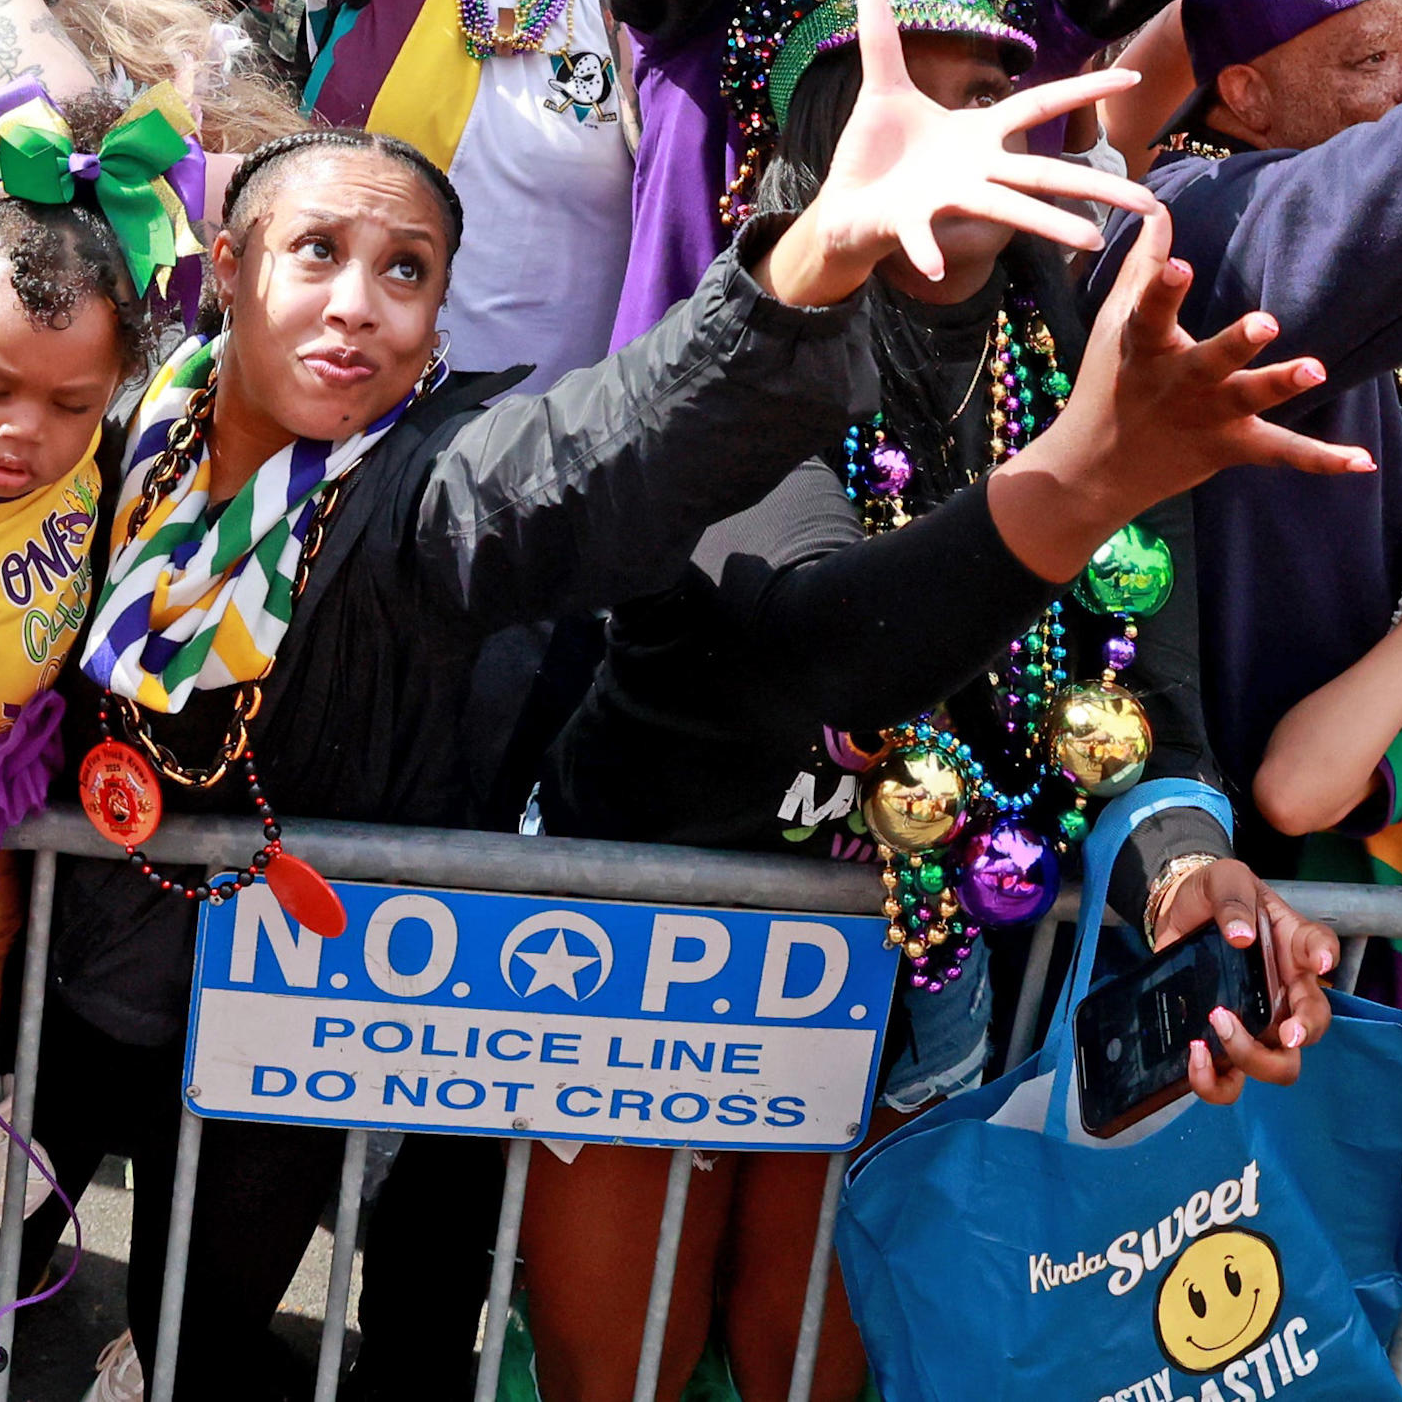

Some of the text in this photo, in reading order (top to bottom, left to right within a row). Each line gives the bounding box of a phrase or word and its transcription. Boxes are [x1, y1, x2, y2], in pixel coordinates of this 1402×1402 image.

[1, 511, 84, 606] ONE
[228, 882, 867, 1021] N.O. P.D.
[312, 1016, 764, 1075] POLICE LINE
[251, 1064, 806, 1128] DO NOT CROSS
[1028, 1159, 1261, 1297] Kinda Sweet
[1180, 1316, 1320, 1402] ASTIC
